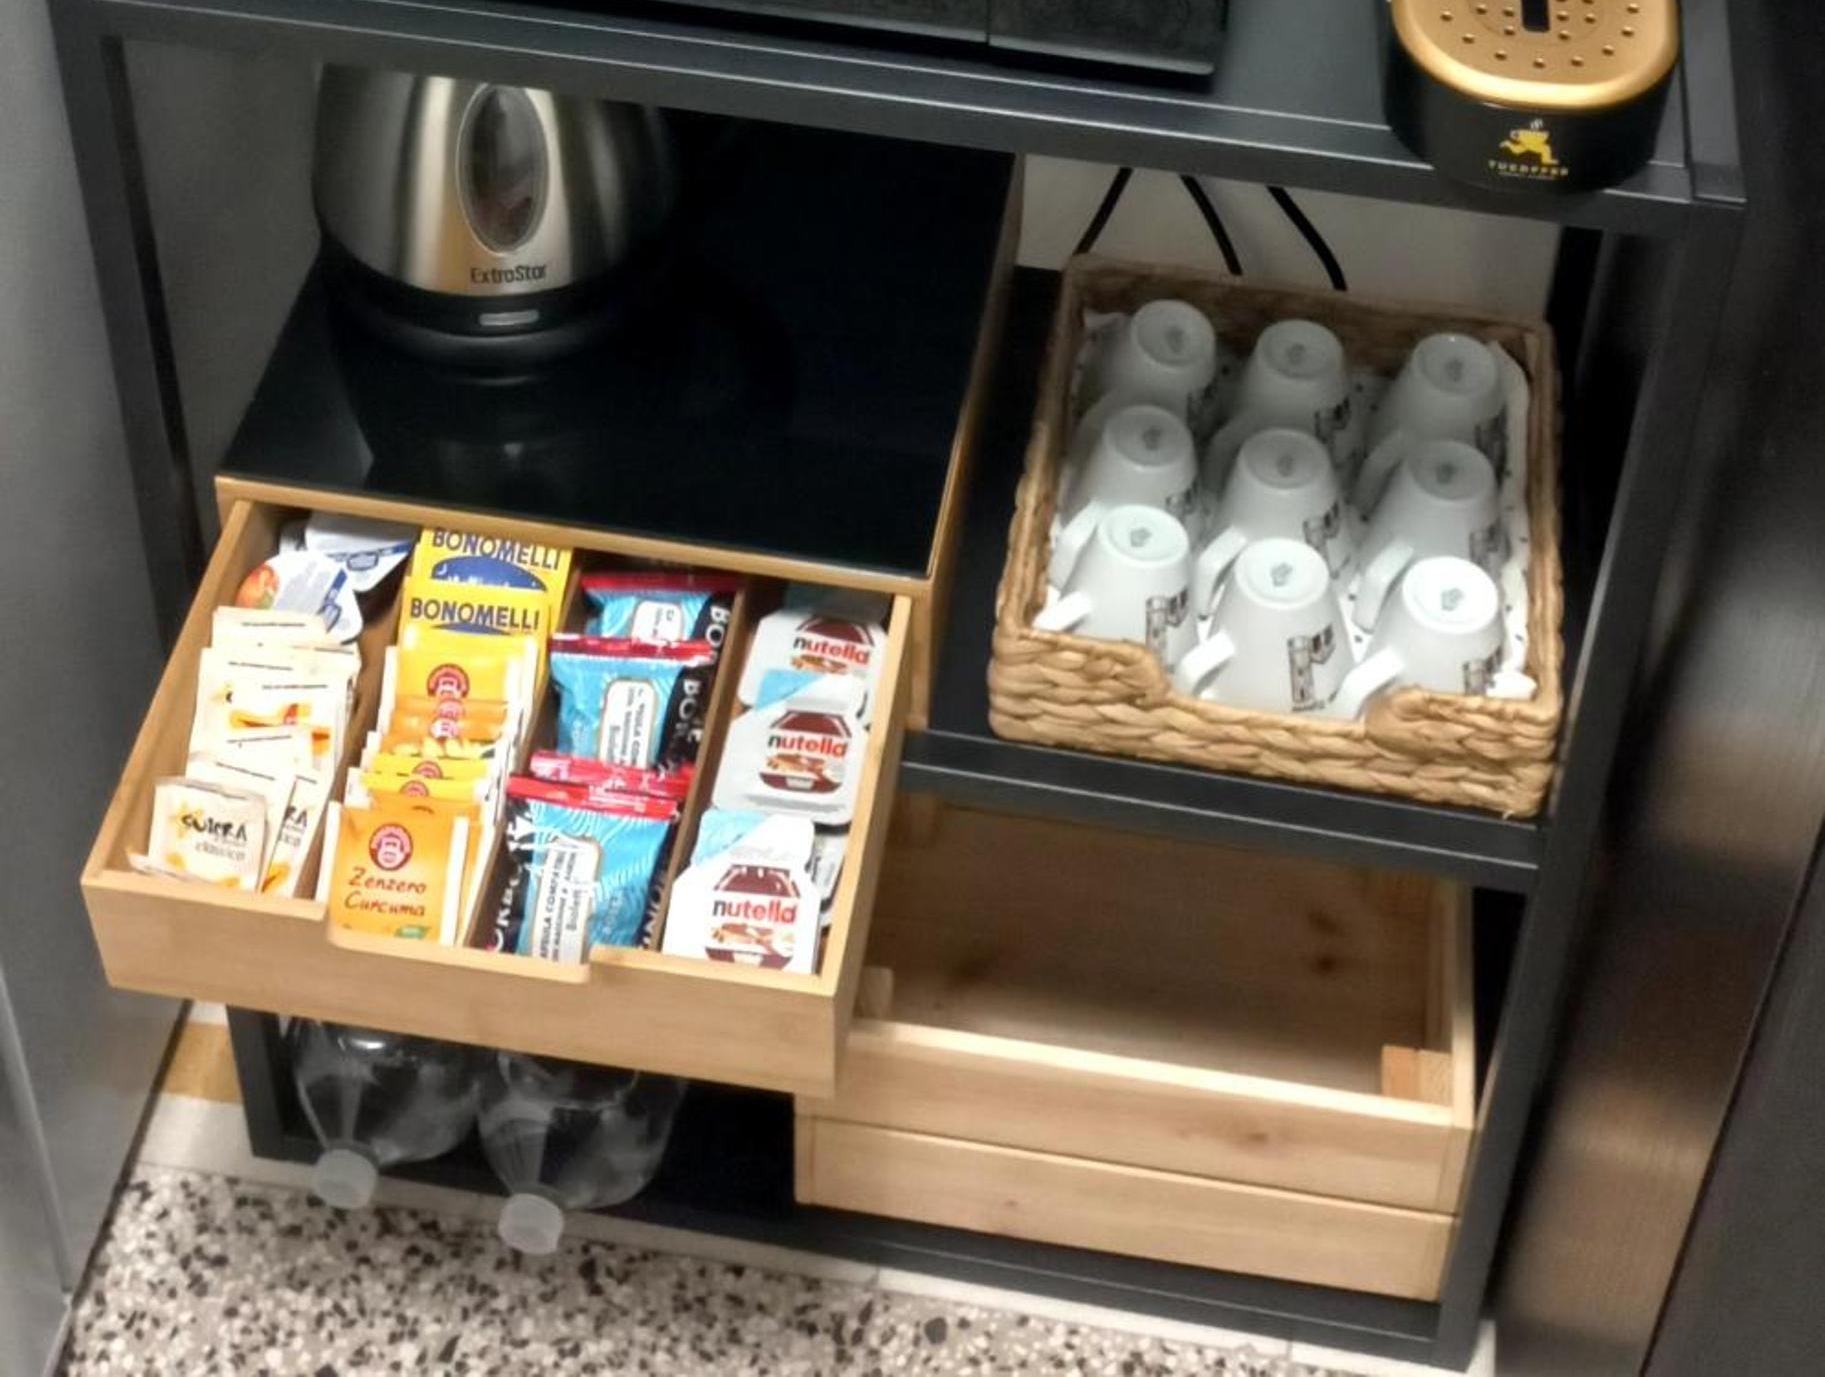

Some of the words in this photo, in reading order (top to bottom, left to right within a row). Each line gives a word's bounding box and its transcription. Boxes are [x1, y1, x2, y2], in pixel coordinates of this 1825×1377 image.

[432, 528, 561, 570] BONOMELLI
[410, 598, 540, 629] BONOMELLI
[793, 636, 870, 665] nutella
[768, 734, 849, 757] nutella
[348, 866, 427, 894] Zenzero
[344, 890, 425, 916] Curcuma
[712, 899, 798, 924] nutella
